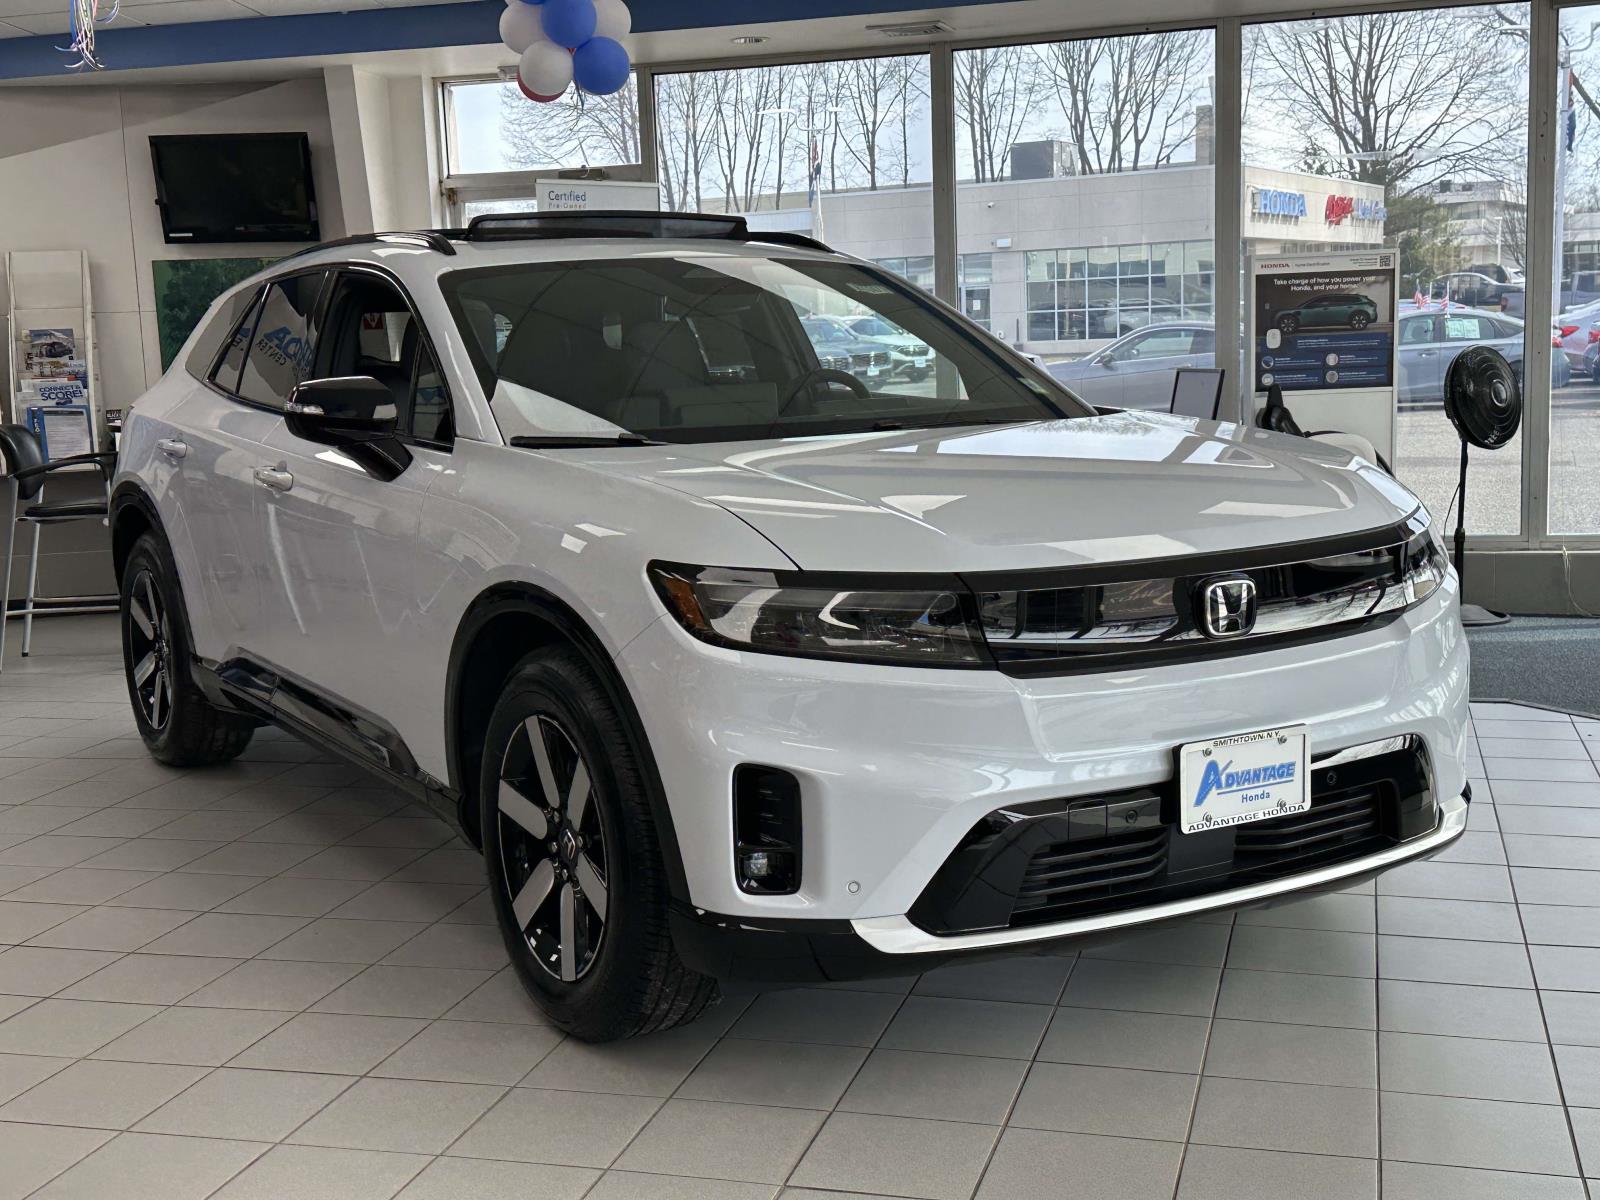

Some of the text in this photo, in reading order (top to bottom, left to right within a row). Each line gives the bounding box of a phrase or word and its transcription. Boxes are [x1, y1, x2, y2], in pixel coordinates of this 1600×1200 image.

[549, 190, 586, 202] Certified
[1260, 188, 1307, 217] HONDA
[1273, 278, 1287, 286] Take
[1288, 277, 1308, 286] charge
[1330, 276, 1341, 284] you
[1342, 275, 1361, 283] power
[1362, 274, 1376, 282] your
[1325, 283, 1339, 291] your
[39, 385, 74, 393] CONNECT
[41, 389, 83, 401] SCORE!
[1193, 760, 1297, 807] ADVANTAGE
[1241, 790, 1271, 803] Honda
[1188, 804, 1305, 832] ADVANTAGE HONDA
